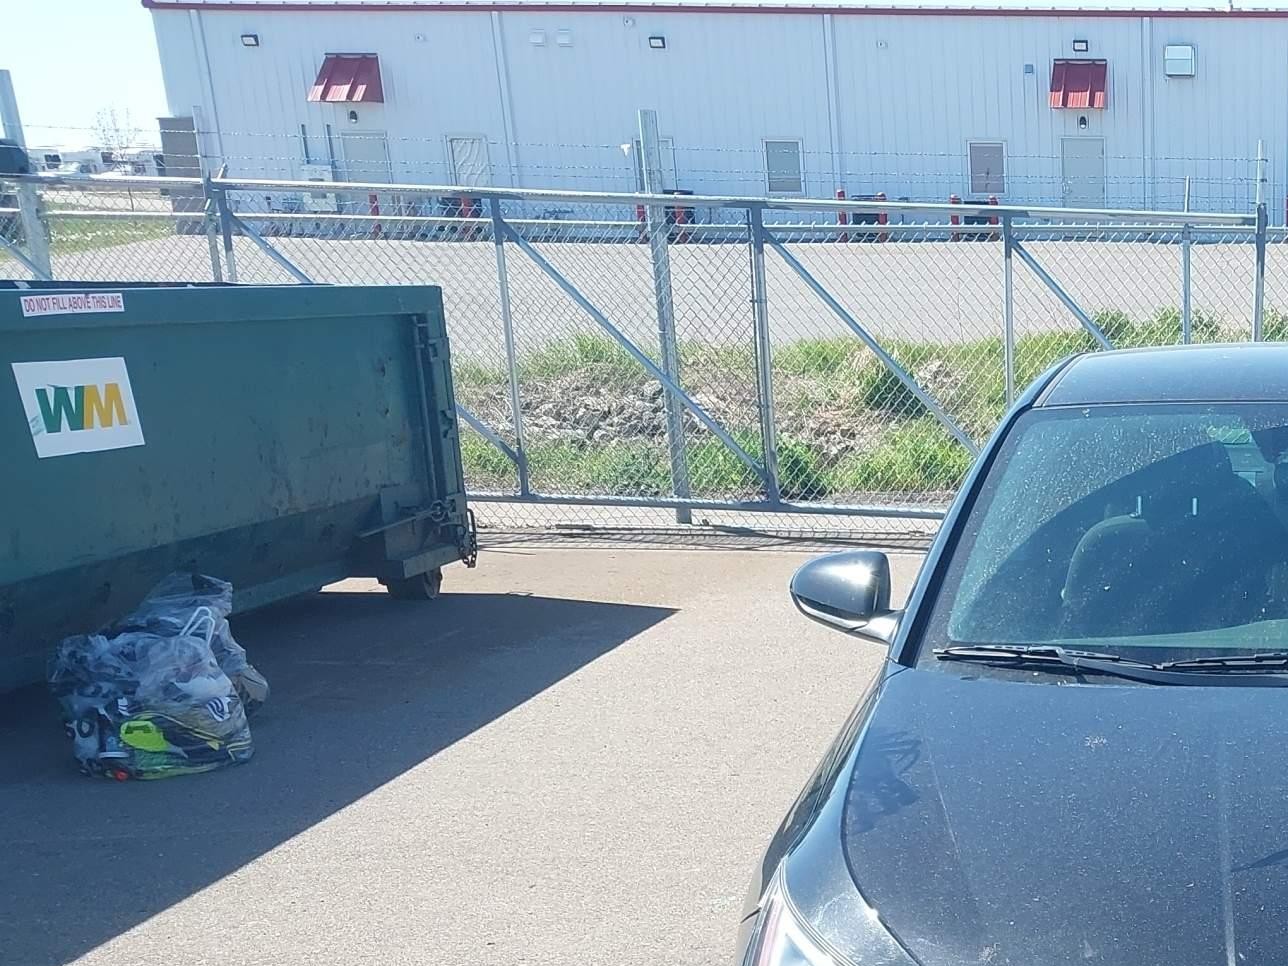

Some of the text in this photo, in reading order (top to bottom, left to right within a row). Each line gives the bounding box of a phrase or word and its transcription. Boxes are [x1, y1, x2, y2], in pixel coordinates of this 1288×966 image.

[24, 295, 122, 312] DO NOT FILL ABOVE THIS LINE
[34, 383, 128, 433] WM
